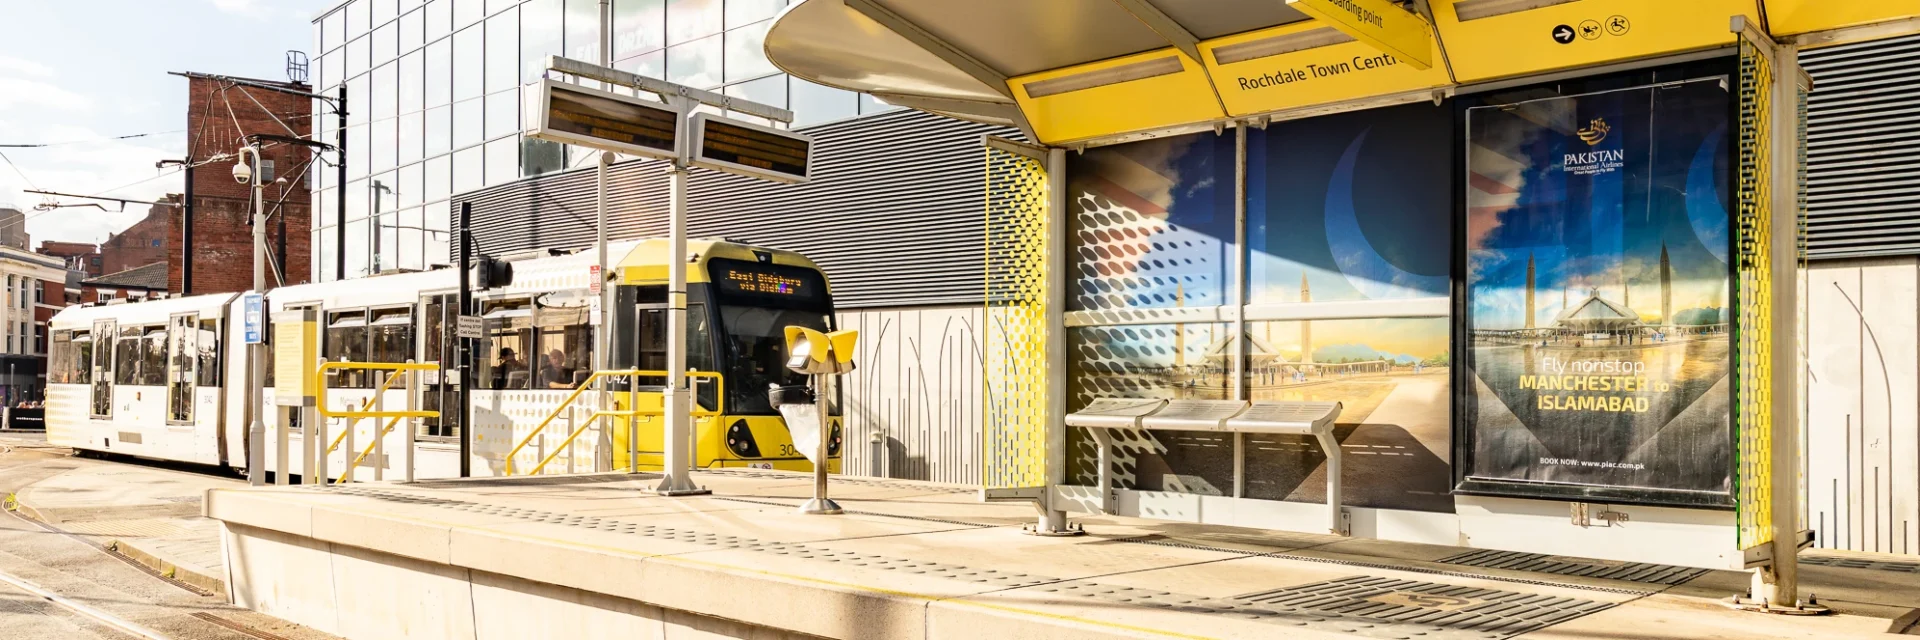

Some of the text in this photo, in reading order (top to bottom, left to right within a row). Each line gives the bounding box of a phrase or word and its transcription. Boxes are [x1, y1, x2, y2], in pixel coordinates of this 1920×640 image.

[1363, 9, 1383, 28] point
[1237, 53, 1404, 91] Rochdale Town Centr
[1563, 149, 1624, 165] PAKISTAN
[1563, 162, 1600, 172] International
[729, 270, 802, 287] East Didsbury
[740, 281, 794, 294] via Oldham
[1542, 357, 1645, 376] Fly nonstop
[1519, 375, 1670, 393] MANCHESTER to
[1537, 395, 1650, 413] ISLAMABAD
[1540, 457, 1645, 470] BOOK NOW: www.piac.com.pk
